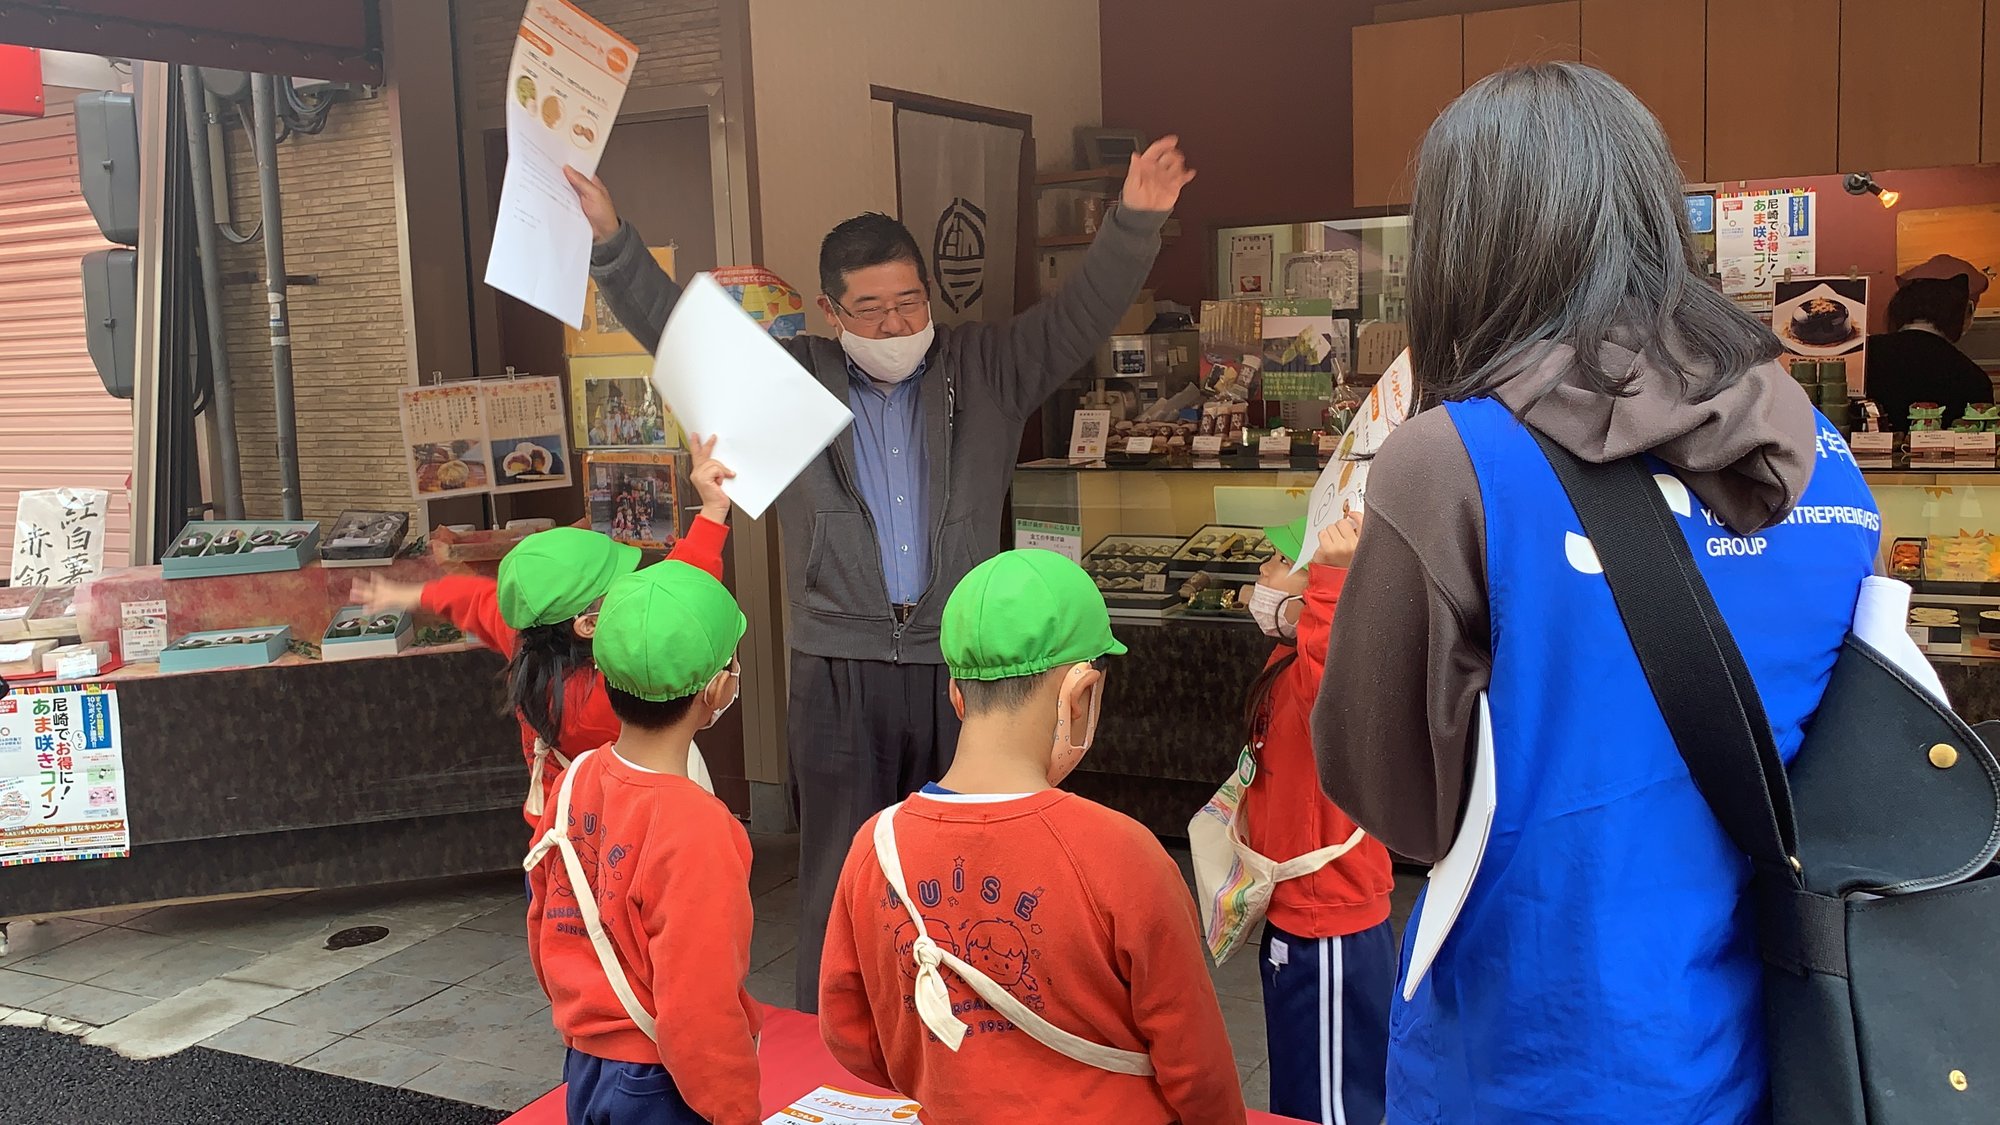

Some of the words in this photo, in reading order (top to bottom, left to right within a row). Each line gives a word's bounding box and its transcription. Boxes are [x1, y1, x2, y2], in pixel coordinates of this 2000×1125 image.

[1753, 200, 1767, 288] あま咲きコイン
[1781, 506, 1880, 531] NTREPRENERS
[1706, 537, 1768, 557] GROUP
[33, 698, 59, 819] あま咲きコイン
[52, 697, 74, 800] 尼崎でお得に！
[813, 1096, 891, 1113] インタビューシート
